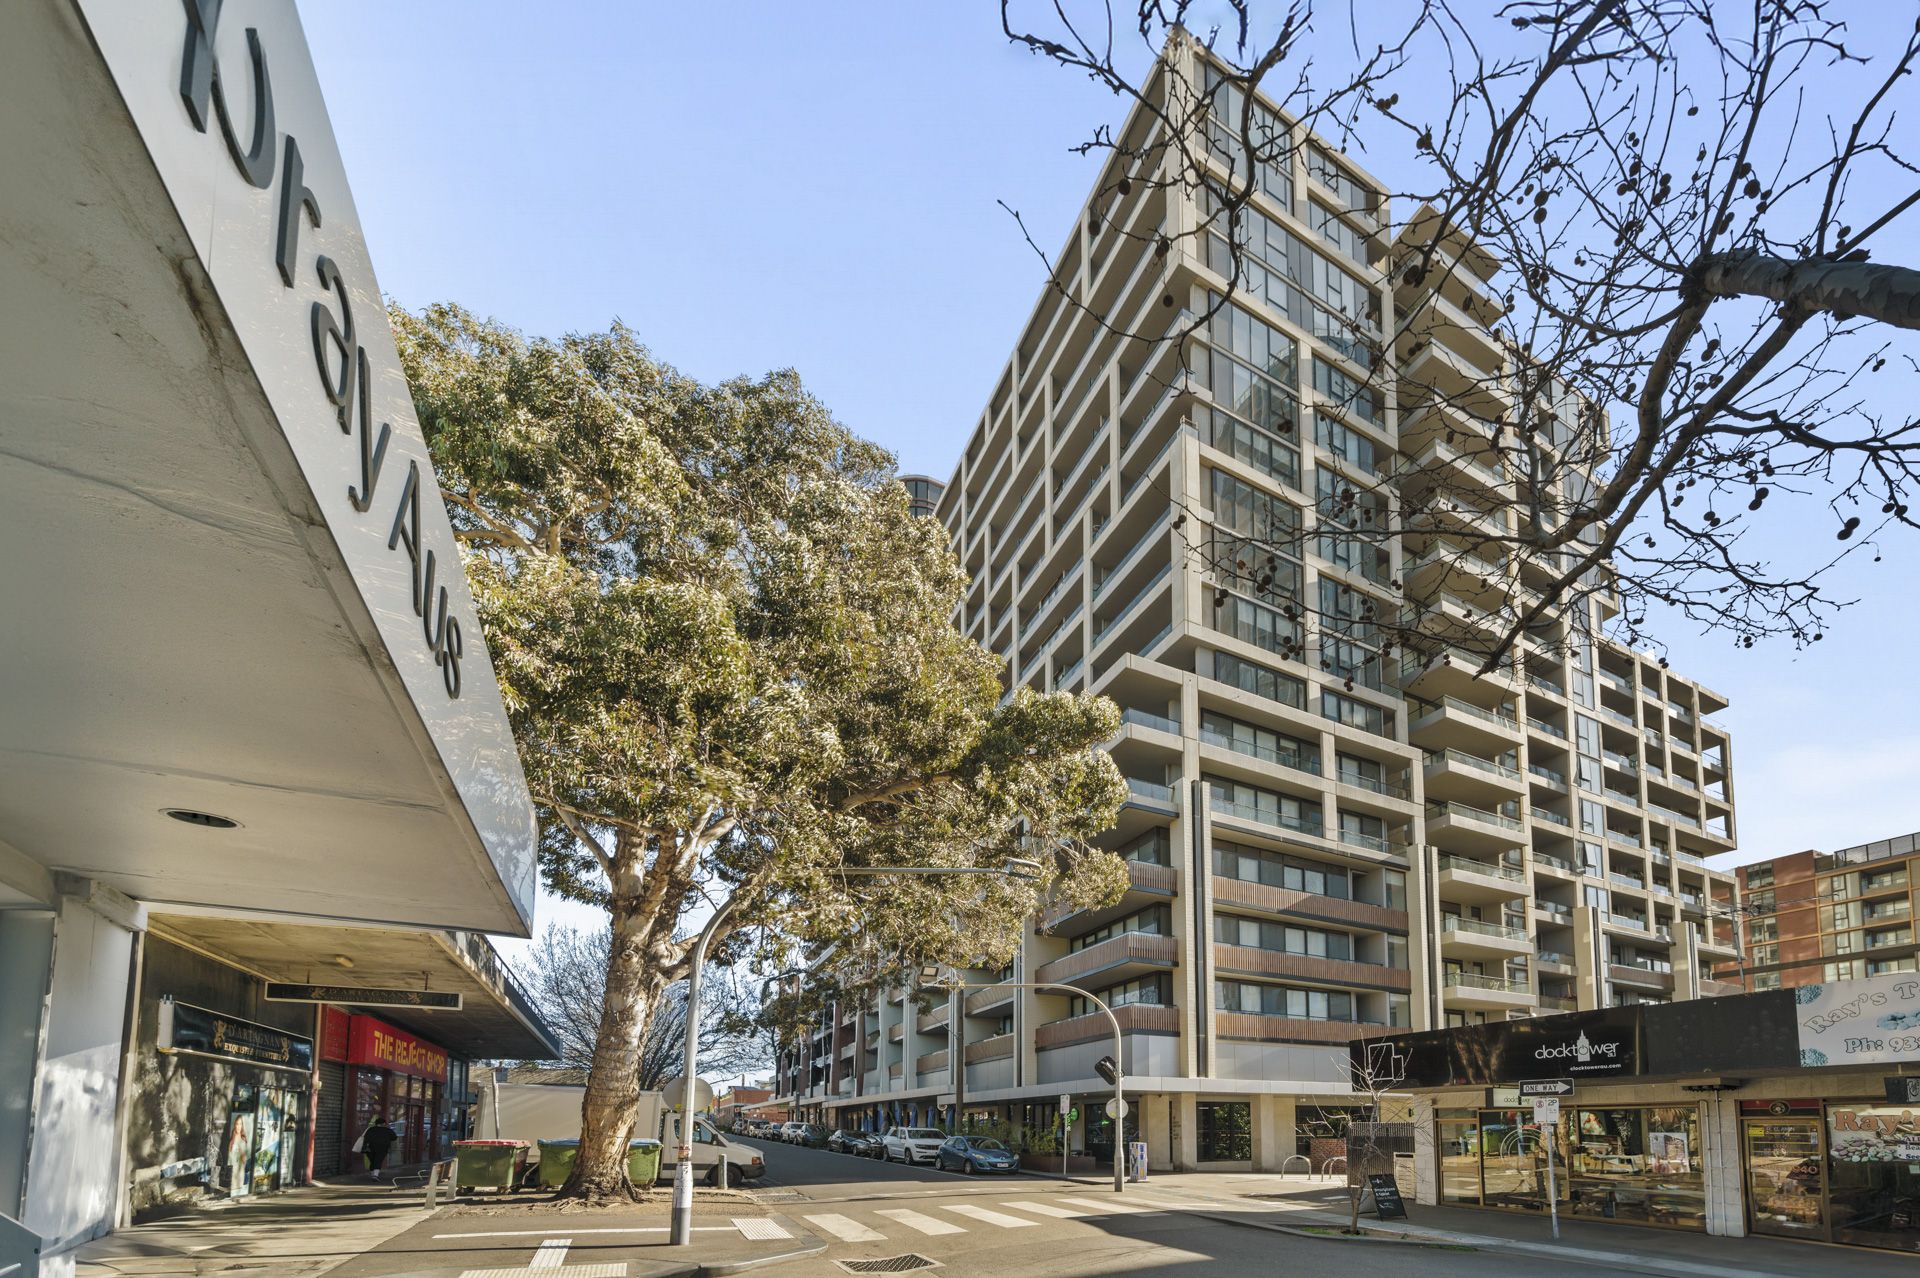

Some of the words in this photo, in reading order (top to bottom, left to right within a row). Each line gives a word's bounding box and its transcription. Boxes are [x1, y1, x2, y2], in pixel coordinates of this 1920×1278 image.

[388, 459, 463, 699] Aus
[1803, 992, 1888, 1034] Ray's
[1893, 981, 1920, 1000] T
[374, 1030, 394, 1061] THE
[395, 1039, 425, 1071] REJECT
[427, 1050, 445, 1075] SHOP
[1535, 1037, 1620, 1061] clocktower
[1844, 1037, 1883, 1053] Ph:
[1889, 1036, 1920, 1053] 93
[1569, 1063, 1622, 1071] clocktowerau.com
[1525, 1084, 1539, 1092] ONE
